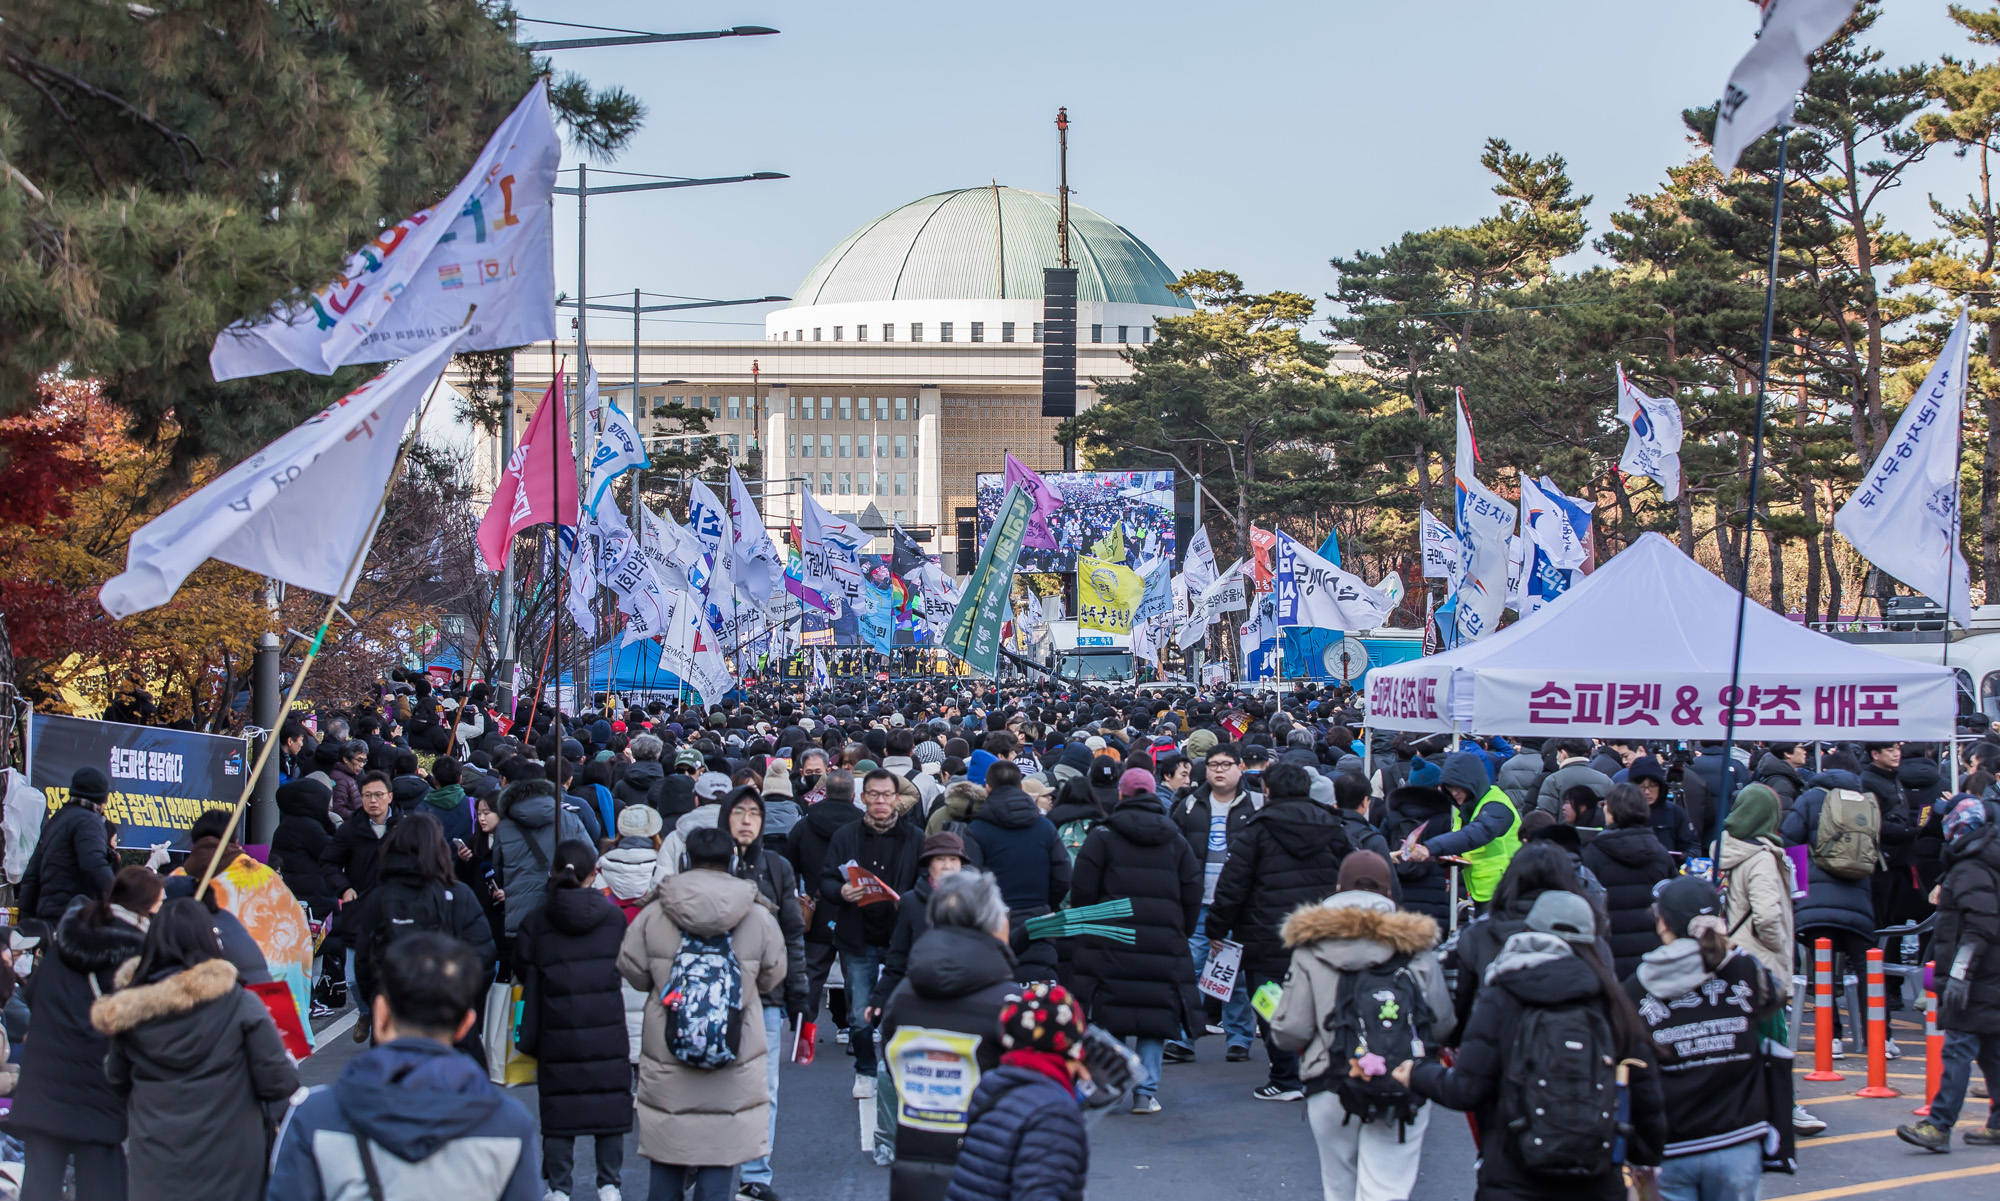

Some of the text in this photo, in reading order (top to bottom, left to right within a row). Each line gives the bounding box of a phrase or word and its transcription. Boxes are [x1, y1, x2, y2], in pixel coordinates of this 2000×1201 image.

[1371, 676, 1394, 718] 손피켓
[1400, 677, 1417, 719] 양초
[1418, 677, 1438, 719] 배포
[1529, 681, 1901, 727] 손피켓 & 양초 배포
[110, 745, 183, 783] 철도파업 정당하다
[125, 793, 171, 828] 중단하고
